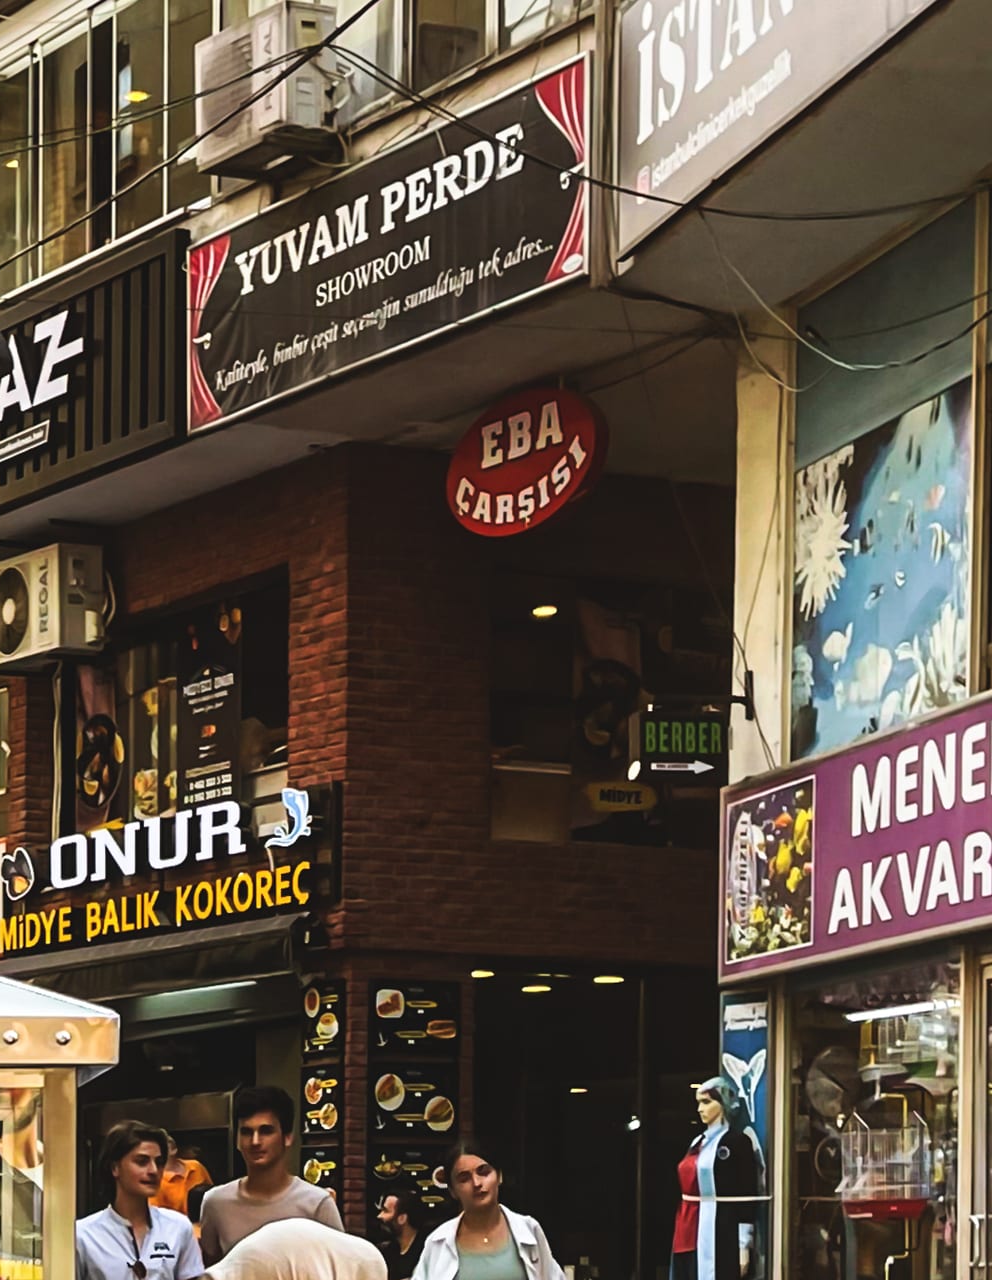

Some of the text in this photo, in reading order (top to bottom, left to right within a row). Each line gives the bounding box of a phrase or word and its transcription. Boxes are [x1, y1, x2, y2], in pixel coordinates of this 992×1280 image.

[234, 123, 525, 295] YUVAM PERDE
[273, 334, 309, 366] binbir
[403, 267, 473, 311] sunulduğu
[479, 248, 503, 280] tek
[316, 236, 430, 307] SHOWROOM
[481, 400, 563, 469] EBA
[456, 435, 586, 528] ÇARŞISI
[39, 558, 49, 633] REGAL
[645, 721, 721, 753] BERBER
[852, 720, 992, 837] MENE
[50, 801, 246, 889] ONUR
[86, 890, 159, 941] BALIK
[176, 861, 310, 926] KOKOREÇ
